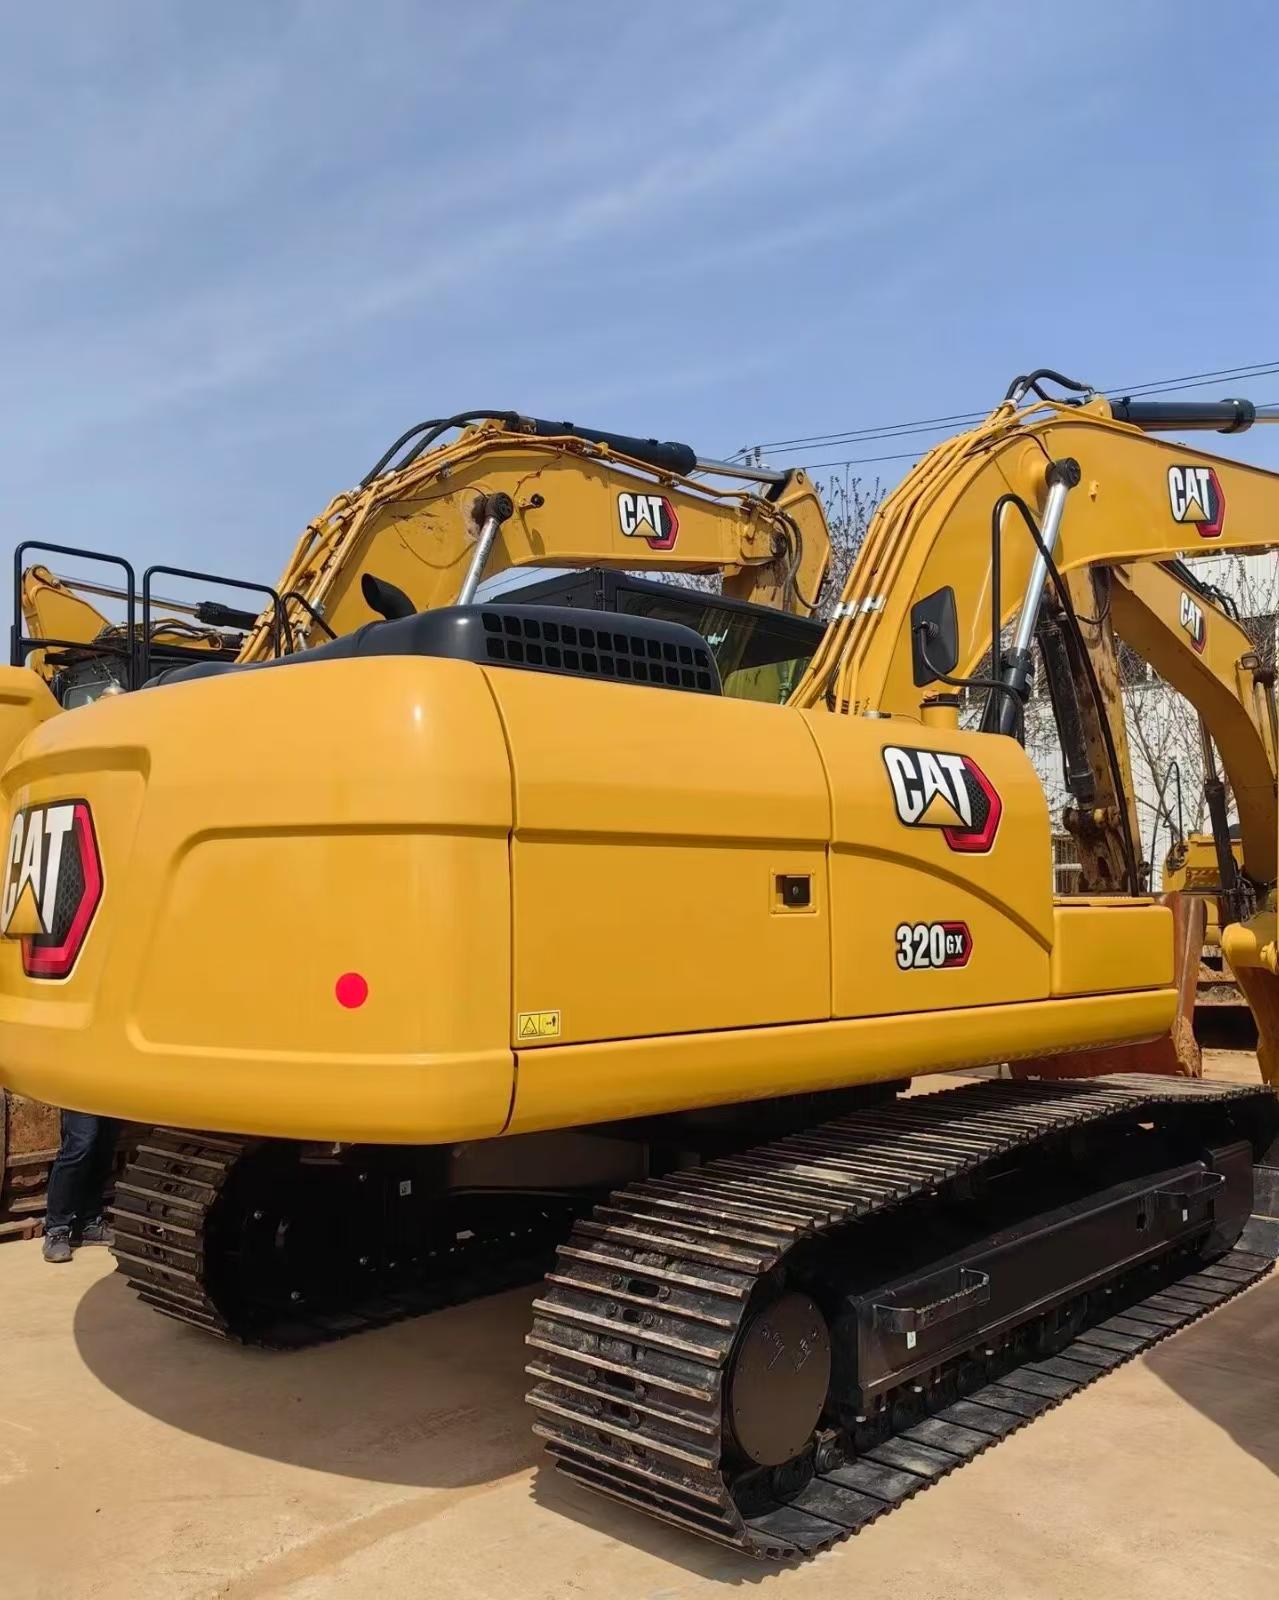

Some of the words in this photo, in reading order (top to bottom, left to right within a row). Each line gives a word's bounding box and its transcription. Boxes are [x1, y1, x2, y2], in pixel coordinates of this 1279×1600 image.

[619, 493, 663, 537] CAT
[1169, 467, 1210, 521] CAT
[1181, 592, 1202, 641] CAT
[884, 747, 972, 827] CAT
[2, 804, 75, 934] CAT
